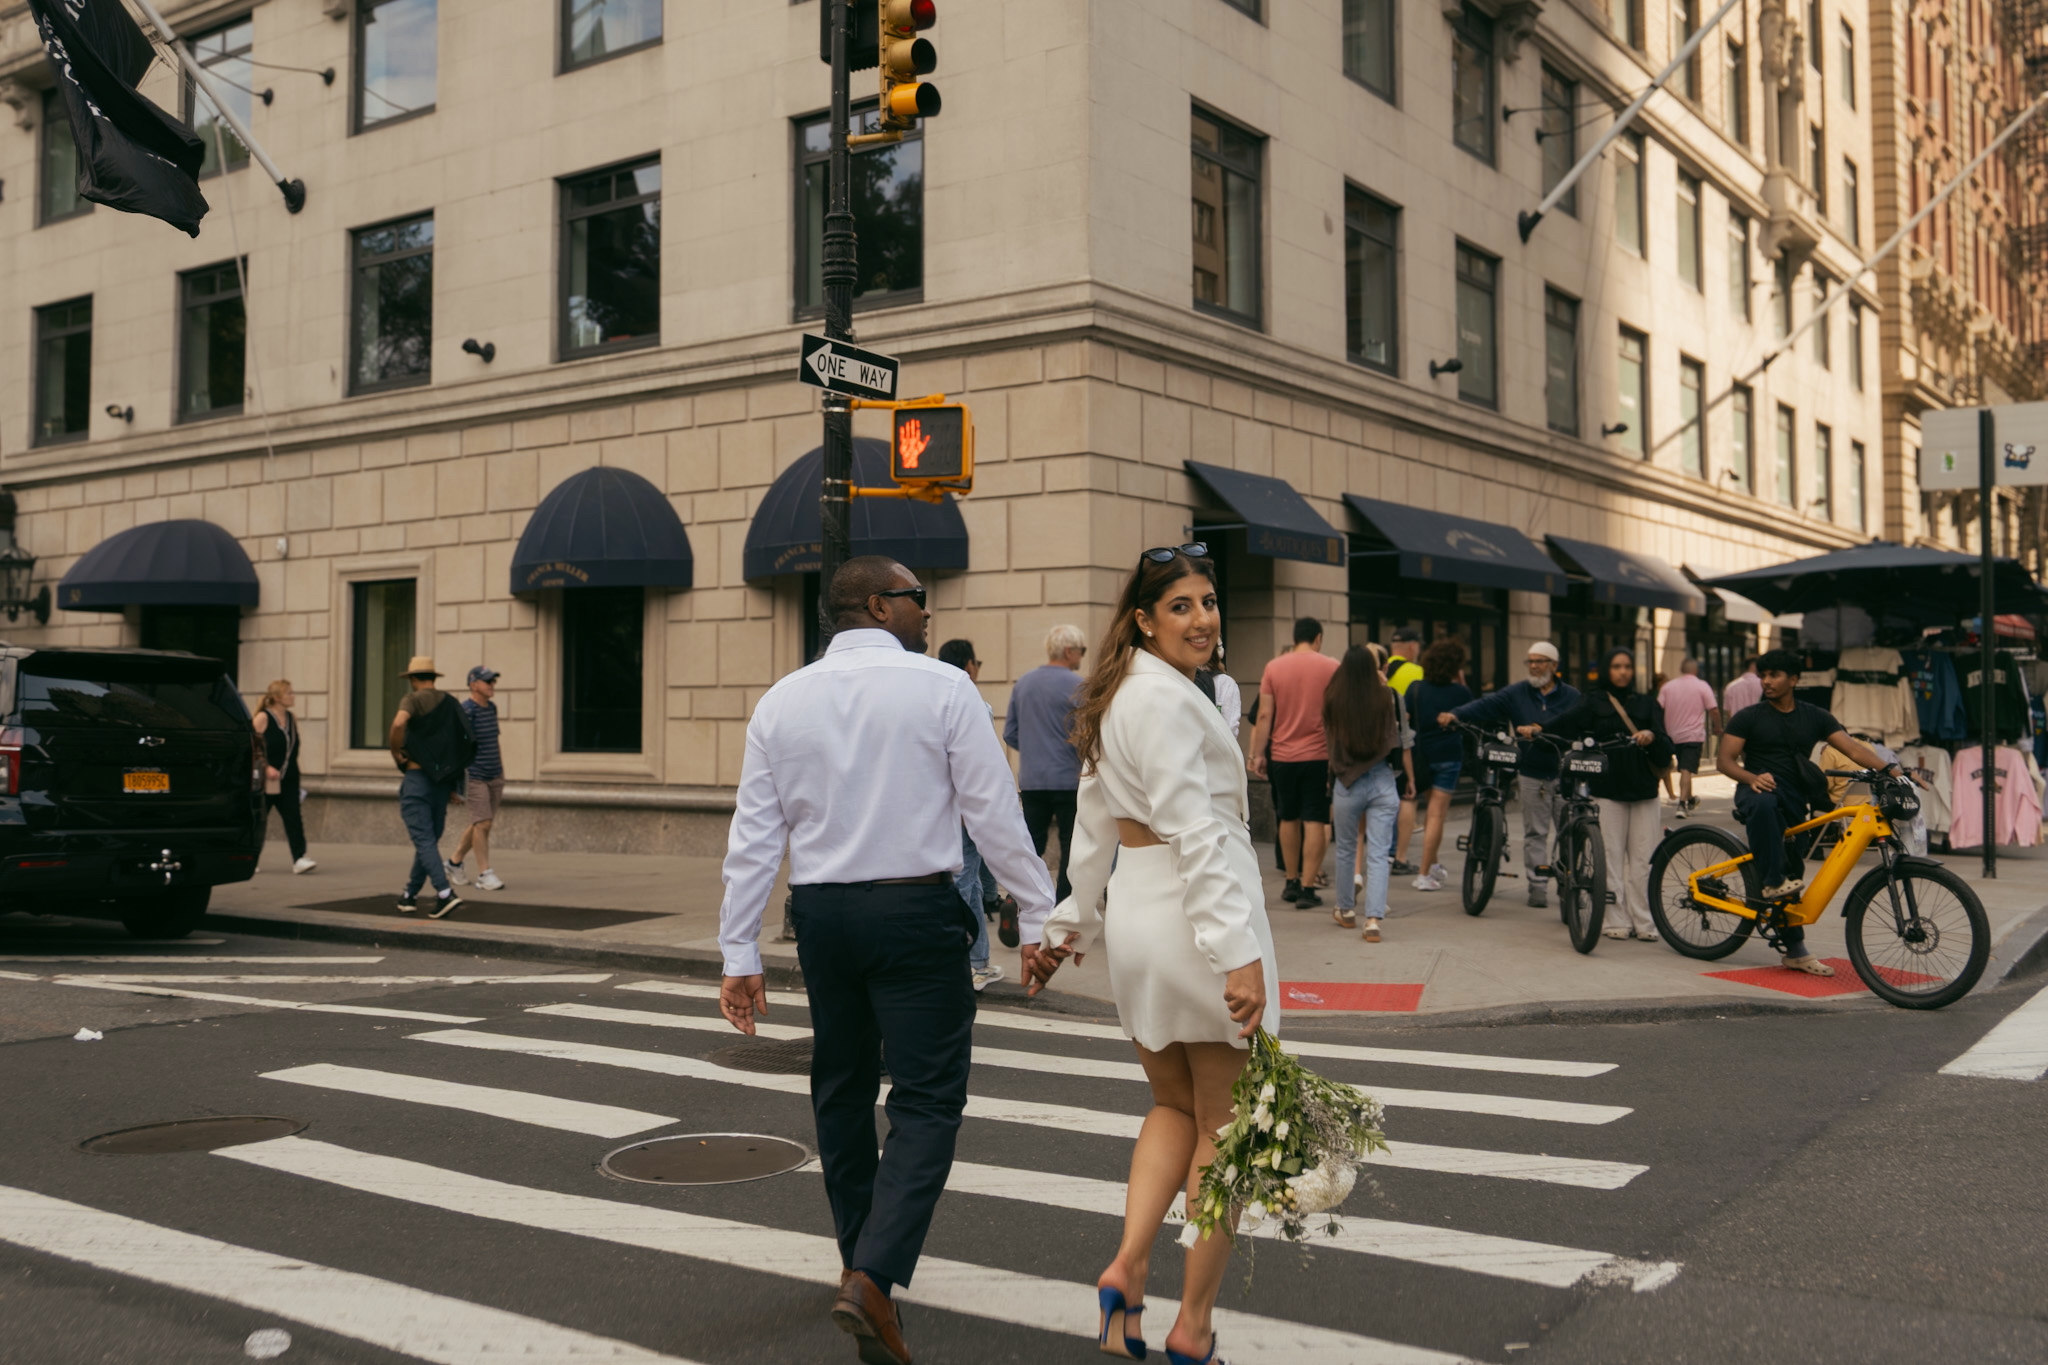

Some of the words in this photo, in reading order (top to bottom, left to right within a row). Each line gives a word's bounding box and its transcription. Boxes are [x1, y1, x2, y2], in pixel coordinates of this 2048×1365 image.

[817, 353, 847, 378] ONE
[860, 364, 887, 389] WAY
[774, 545, 807, 571] FRANCK
[1489, 754, 1517, 764] BIKING
[1570, 764, 1602, 773] BIKING
